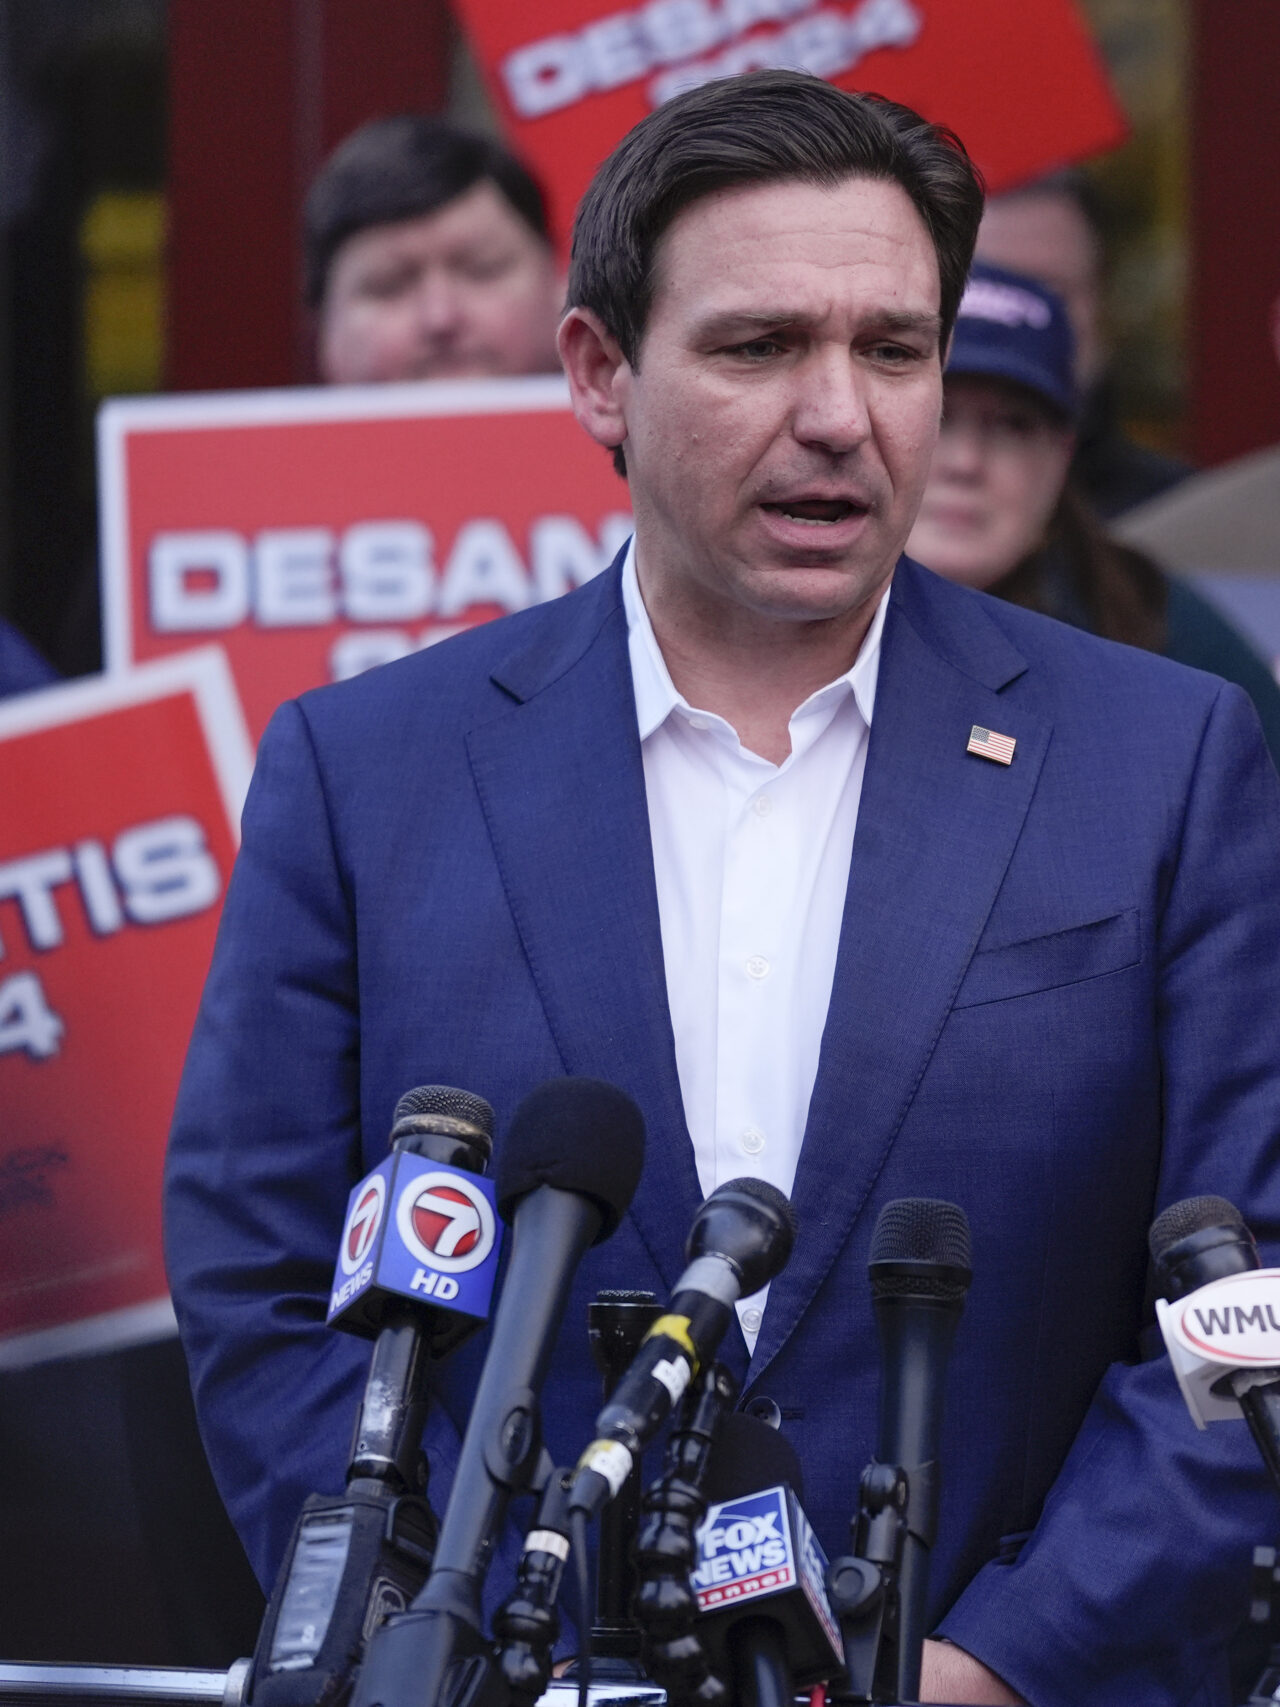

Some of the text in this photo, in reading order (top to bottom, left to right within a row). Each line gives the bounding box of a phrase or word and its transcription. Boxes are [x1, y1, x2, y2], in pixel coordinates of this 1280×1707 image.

[329, 1261, 374, 1313] NEWS
[410, 1268, 459, 1301] HD
[703, 1511, 779, 1559] FOX
[690, 1539, 786, 1588] NEWS
